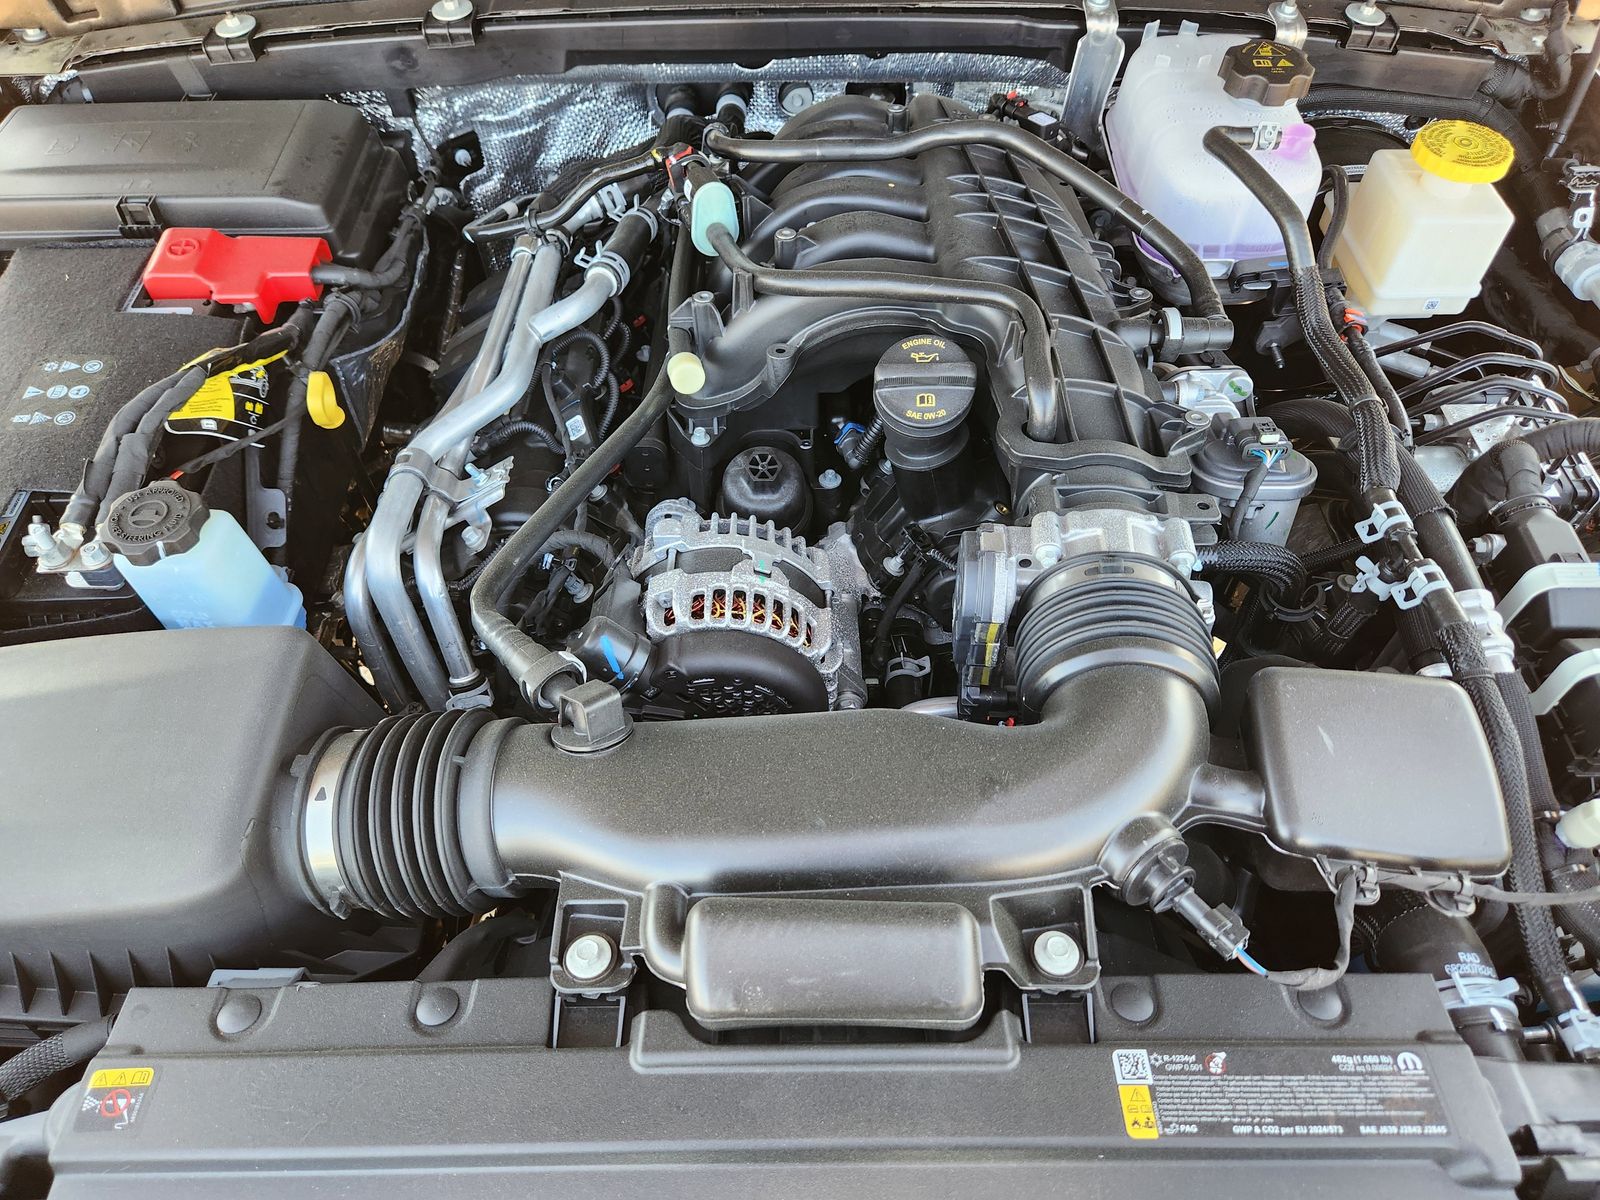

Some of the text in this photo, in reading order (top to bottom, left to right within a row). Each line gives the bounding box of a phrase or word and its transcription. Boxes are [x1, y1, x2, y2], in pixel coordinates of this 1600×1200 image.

[901, 338, 946, 350] ENGINE OIL
[906, 409, 947, 420] SAE 0W-20
[146, 486, 184, 503] APPROVED
[120, 528, 164, 542] STEERING
[1457, 951, 1480, 963] RAD
[1165, 1064, 1184, 1072] GWP
[1180, 1125, 1198, 1134] PAG
[1232, 1125, 1253, 1134] GWP
[1254, 1125, 1261, 1134] &
[1262, 1125, 1280, 1134] CO2
[1280, 1126, 1294, 1136] per
[1295, 1125, 1307, 1134] EU
